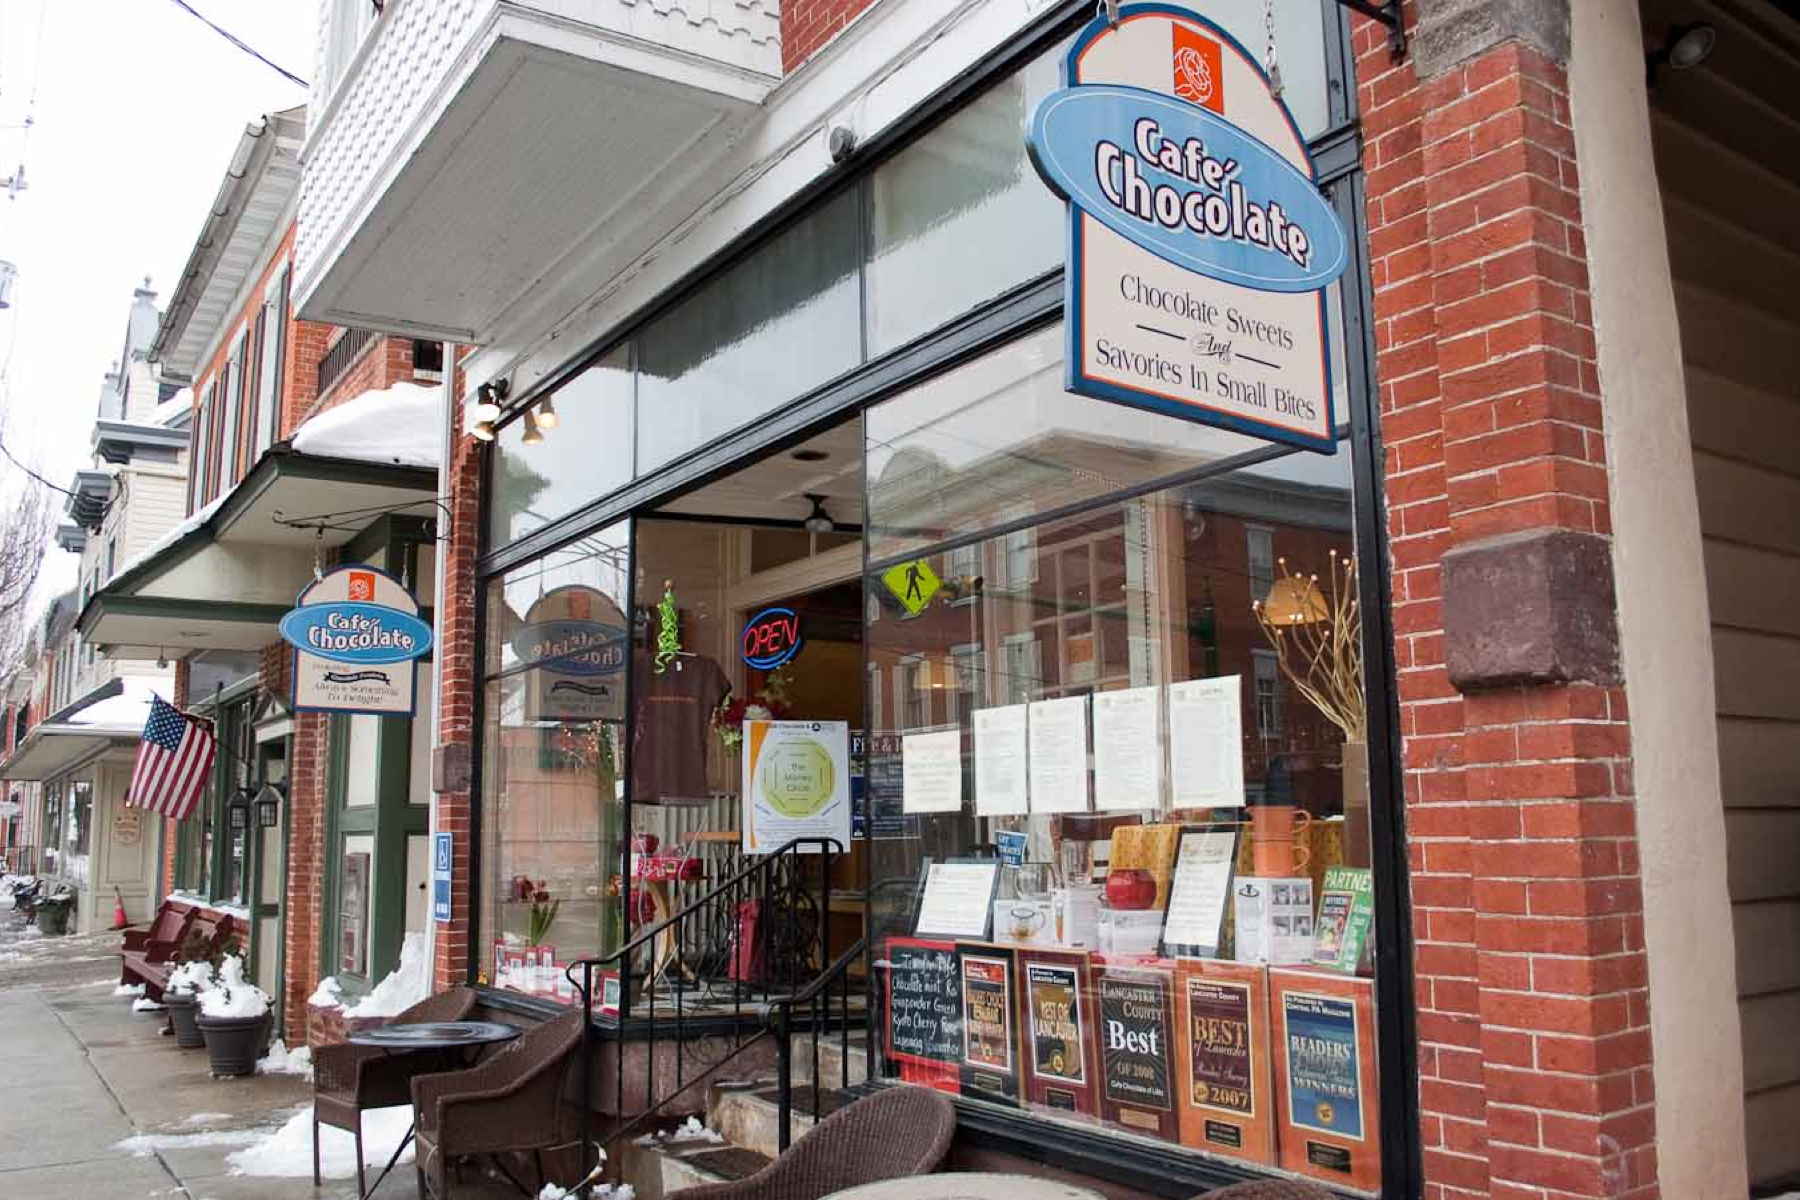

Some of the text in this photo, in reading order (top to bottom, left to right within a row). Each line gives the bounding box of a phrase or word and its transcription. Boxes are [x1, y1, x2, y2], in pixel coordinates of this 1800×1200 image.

[1095, 140, 1309, 268] Chocolate
[1120, 273, 1294, 350] Chocolate Sweets
[1190, 331, 1233, 362] And
[1095, 338, 1316, 420] Savories In Small Bites
[308, 624, 416, 652] Chocolate
[743, 615, 799, 658] OPEN
[1107, 1019, 1159, 1056] Best
[1194, 1015, 1247, 1048] BEST
[1210, 1086, 1249, 1110] 2007
